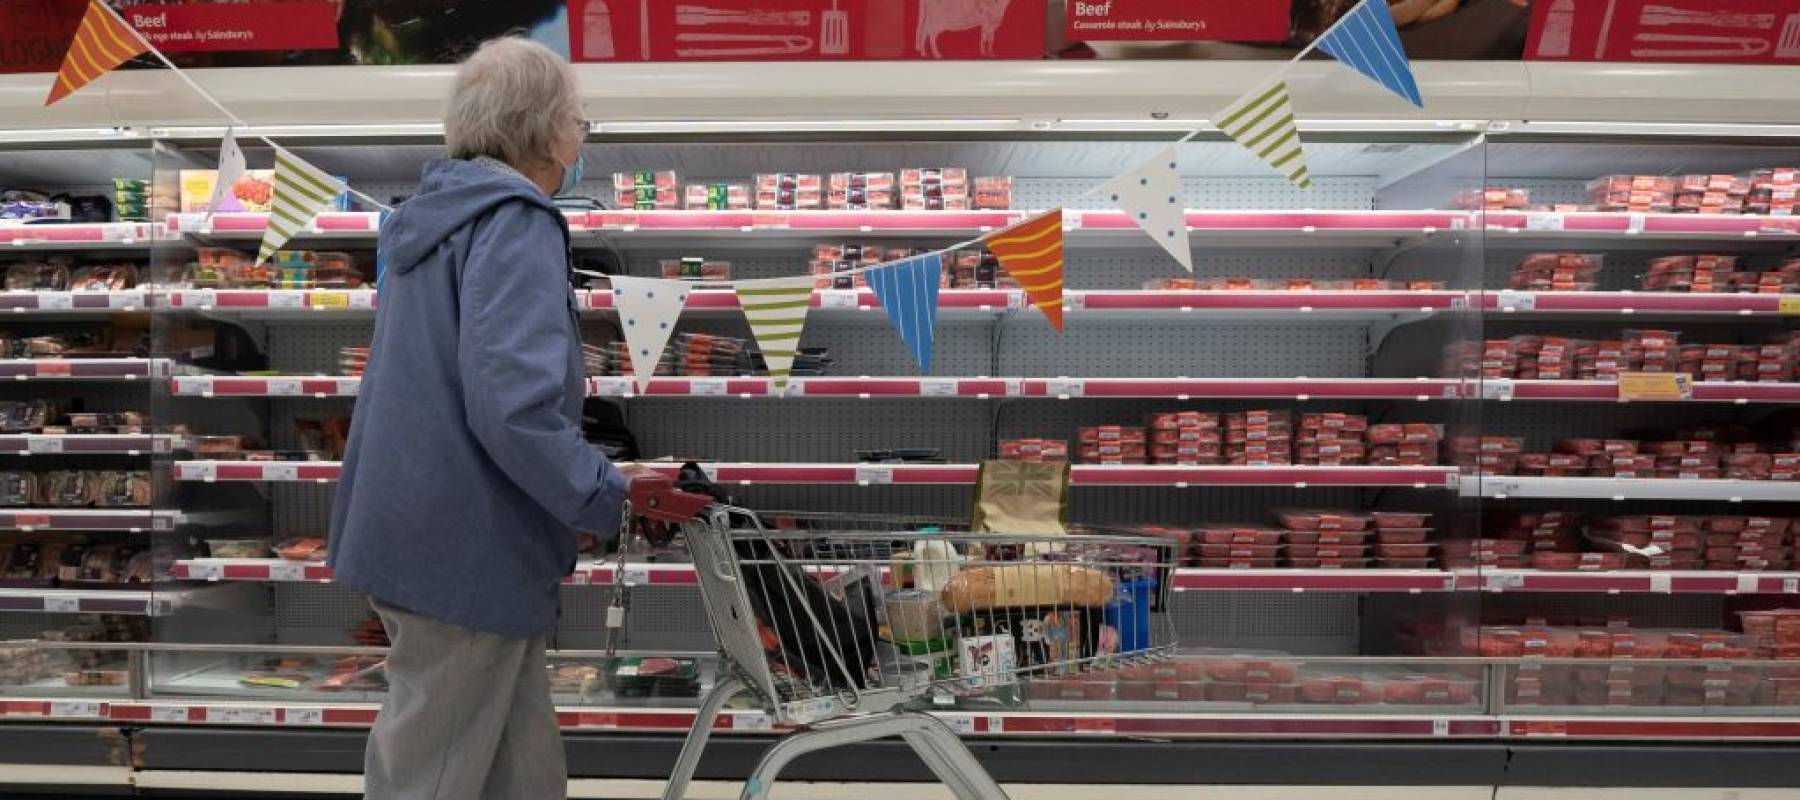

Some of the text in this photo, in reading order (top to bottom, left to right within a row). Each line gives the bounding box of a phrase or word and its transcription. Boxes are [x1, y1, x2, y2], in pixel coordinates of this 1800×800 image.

[1075, 1, 1111, 16] Beef
[133, 12, 166, 27] Beef
[1074, 20, 1115, 29] Casserole
[1117, 20, 1141, 29] steak
[1156, 20, 1206, 31] Sainsbury's
[170, 30, 193, 40] steak
[207, 30, 254, 41] Sainsbury's
